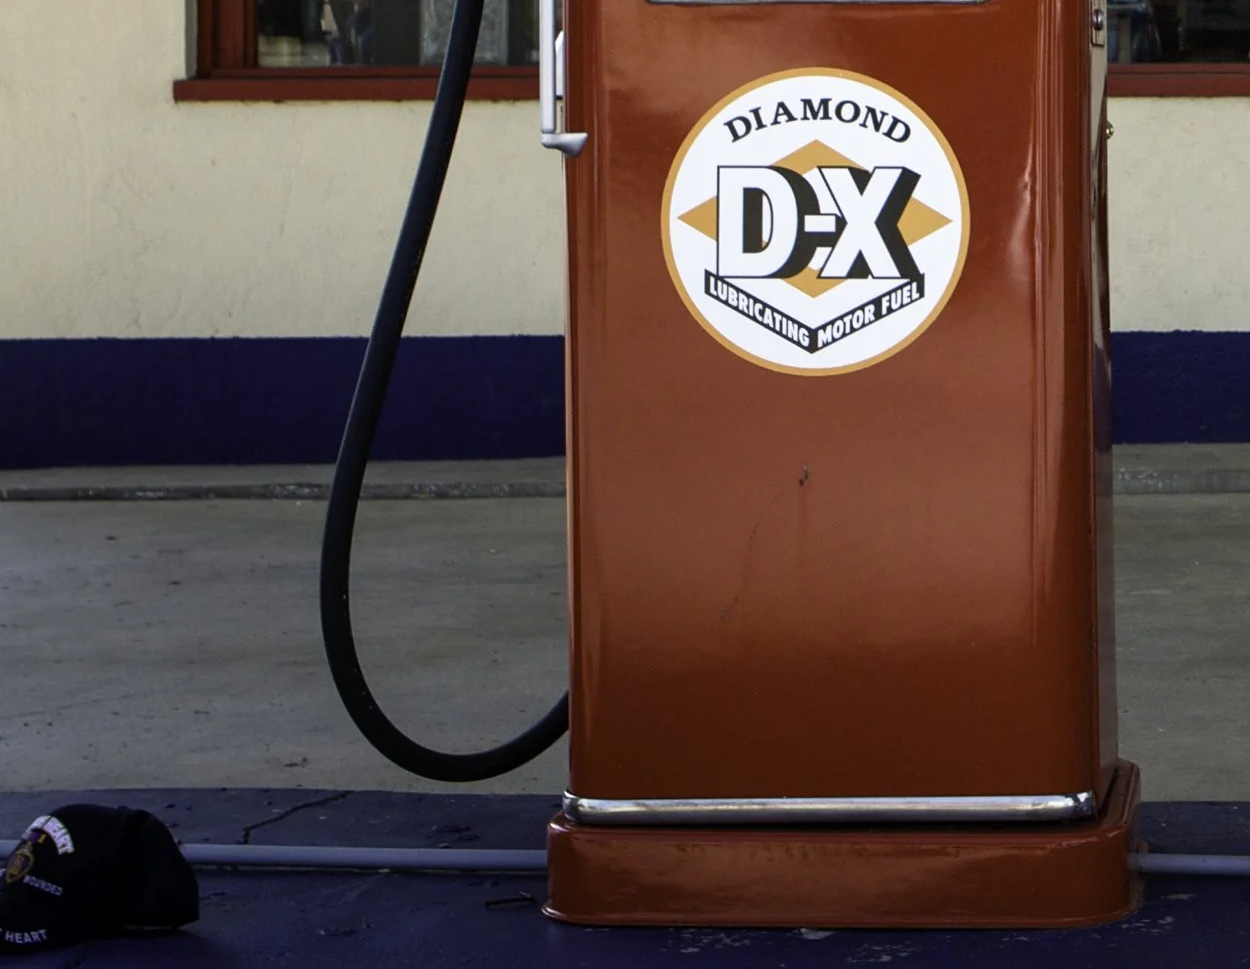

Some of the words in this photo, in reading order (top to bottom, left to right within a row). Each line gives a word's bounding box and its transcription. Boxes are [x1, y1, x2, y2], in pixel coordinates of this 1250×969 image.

[723, 98, 911, 143] DIAMOND
[717, 165, 921, 279] D-X
[709, 275, 810, 348] LUBRICATING
[817, 304, 875, 348] MOTOR
[881, 281, 920, 314] FUEL
[5, 929, 47, 944] HEART
